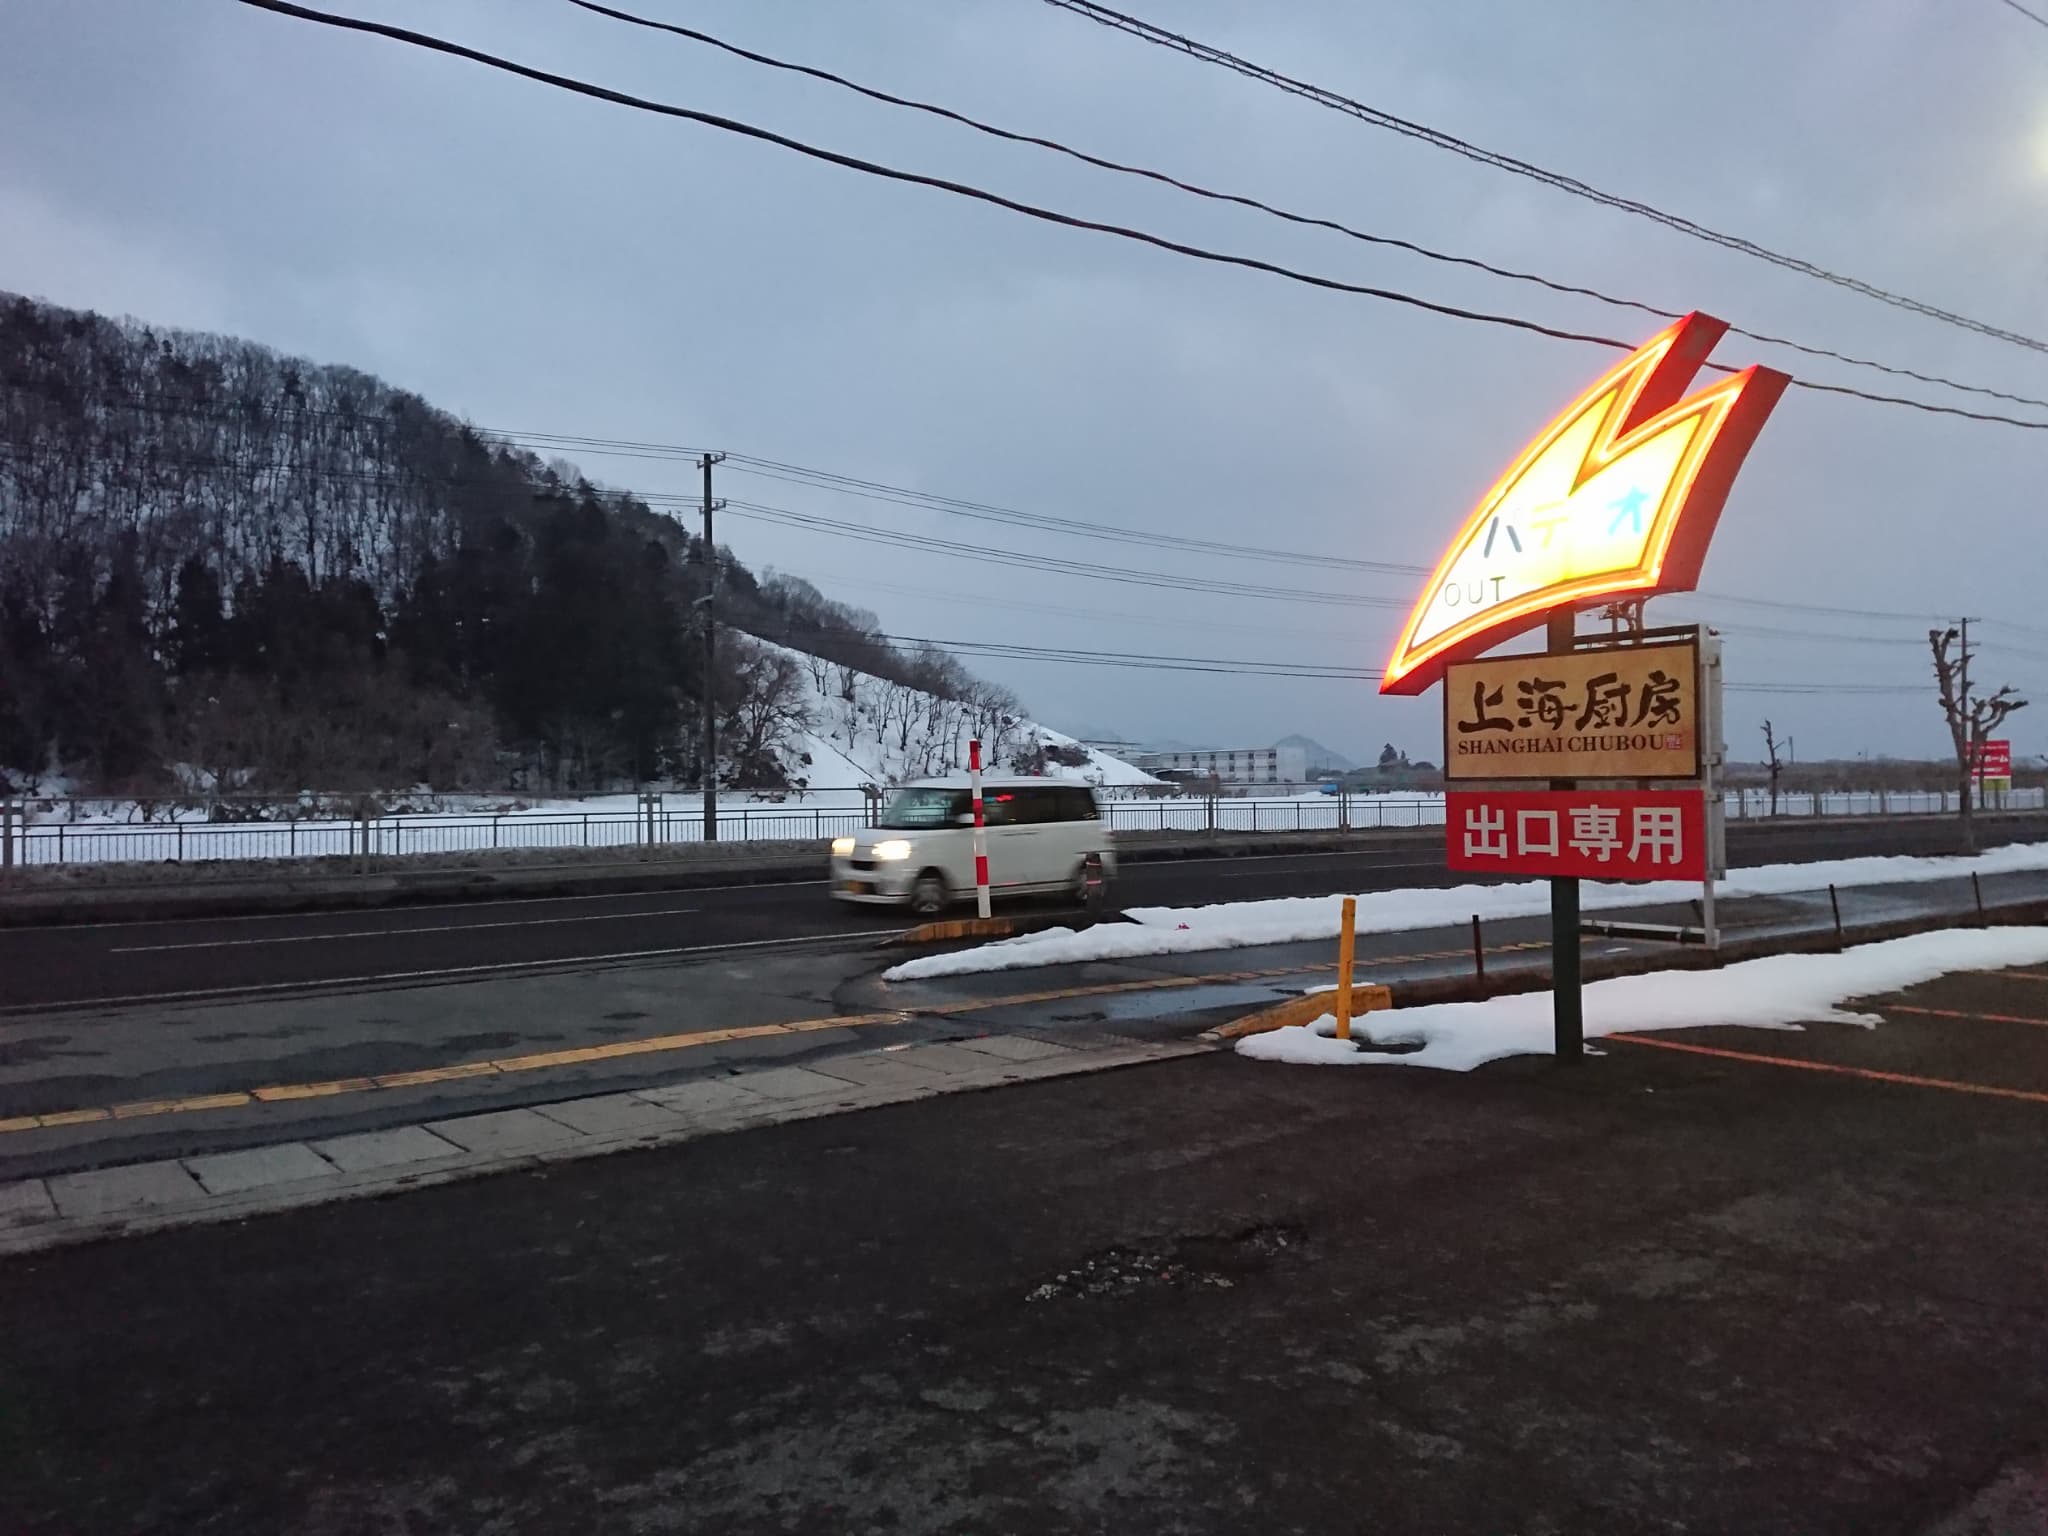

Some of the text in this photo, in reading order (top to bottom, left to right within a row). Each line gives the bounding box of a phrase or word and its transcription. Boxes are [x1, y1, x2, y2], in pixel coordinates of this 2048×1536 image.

[1444, 576, 1507, 607] OUT
[1457, 670, 1681, 733] 上海厨房
[1457, 736, 1563, 755] SHANGHAI
[1567, 734, 1665, 753] CHUBOU
[1463, 804, 1683, 865] 出口専用
